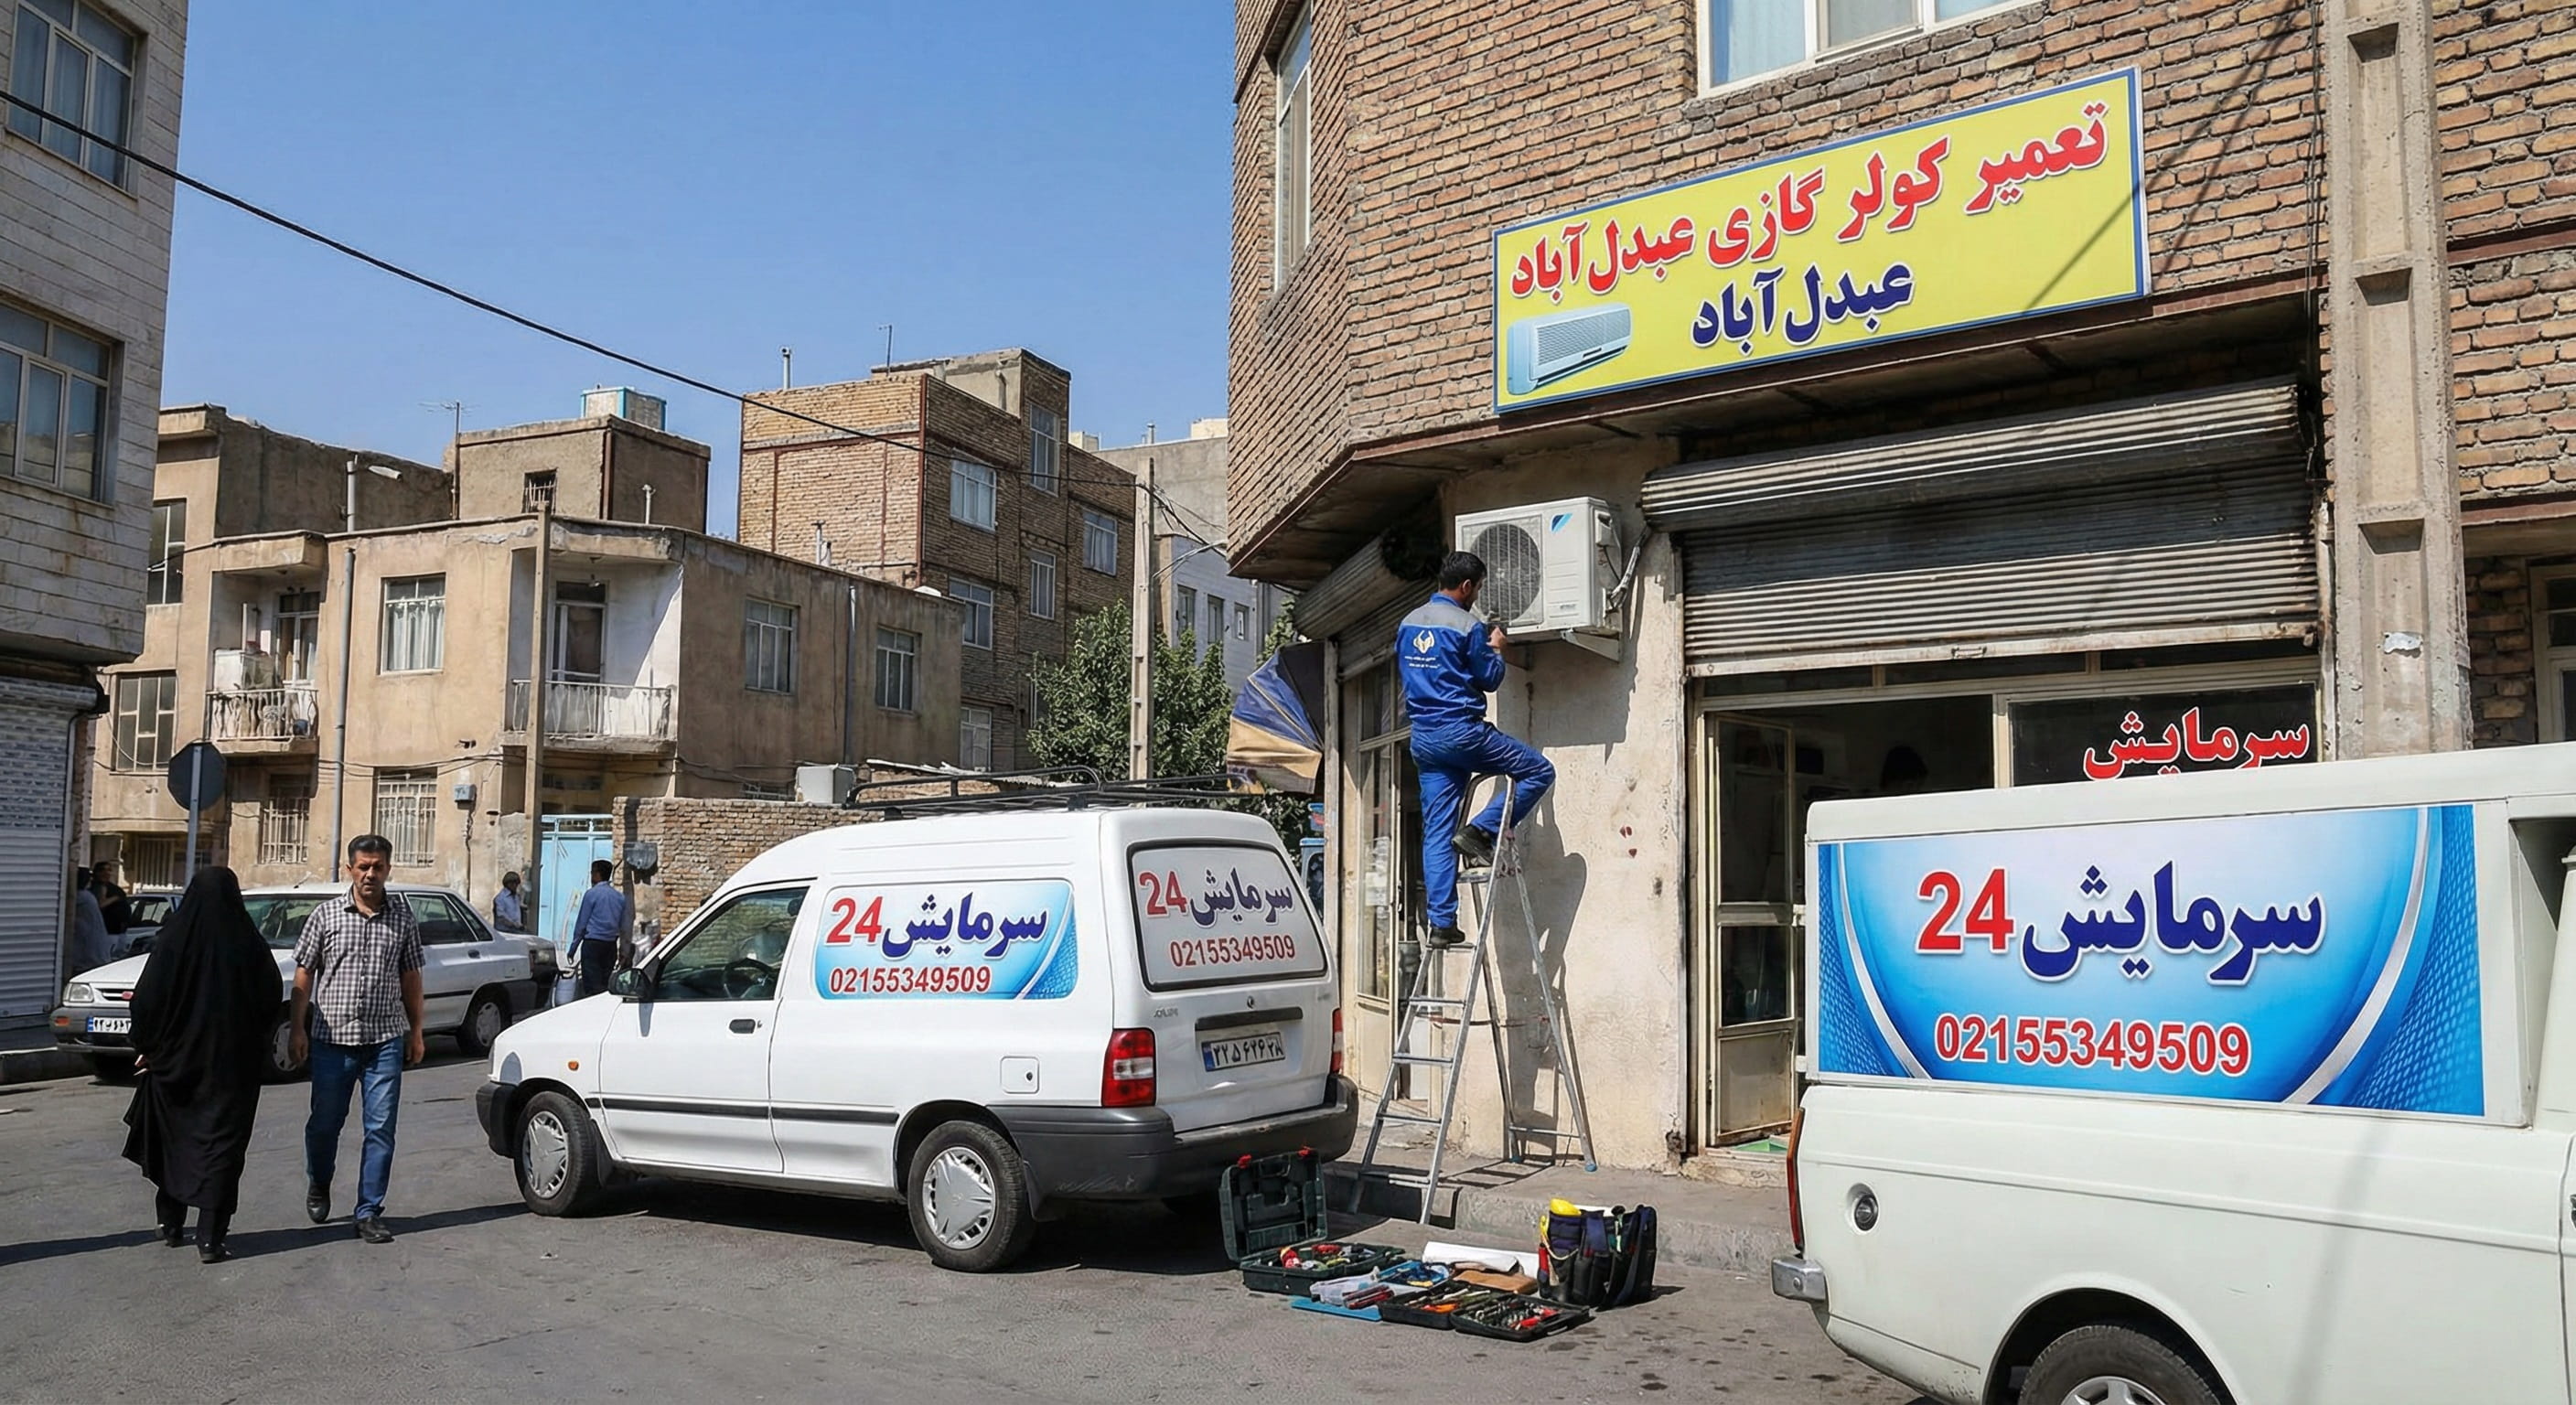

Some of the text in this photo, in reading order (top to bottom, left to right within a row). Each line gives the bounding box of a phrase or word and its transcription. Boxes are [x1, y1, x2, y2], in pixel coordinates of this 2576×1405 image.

[1837, 137, 1950, 241] کولر
[1965, 102, 2108, 213] تعمیر
[1706, 171, 1825, 266] گازی
[2082, 706, 2311, 780] سرمایش
[825, 891, 1048, 959] سرمایش 24
[1138, 866, 1294, 928] سرمایش 24
[1916, 860, 2324, 983] سرمایش 24
[830, 965, 993, 993] 02155349509
[1169, 934, 1296, 968] 02155349509
[1934, 1013, 2252, 1077] 02155349509
